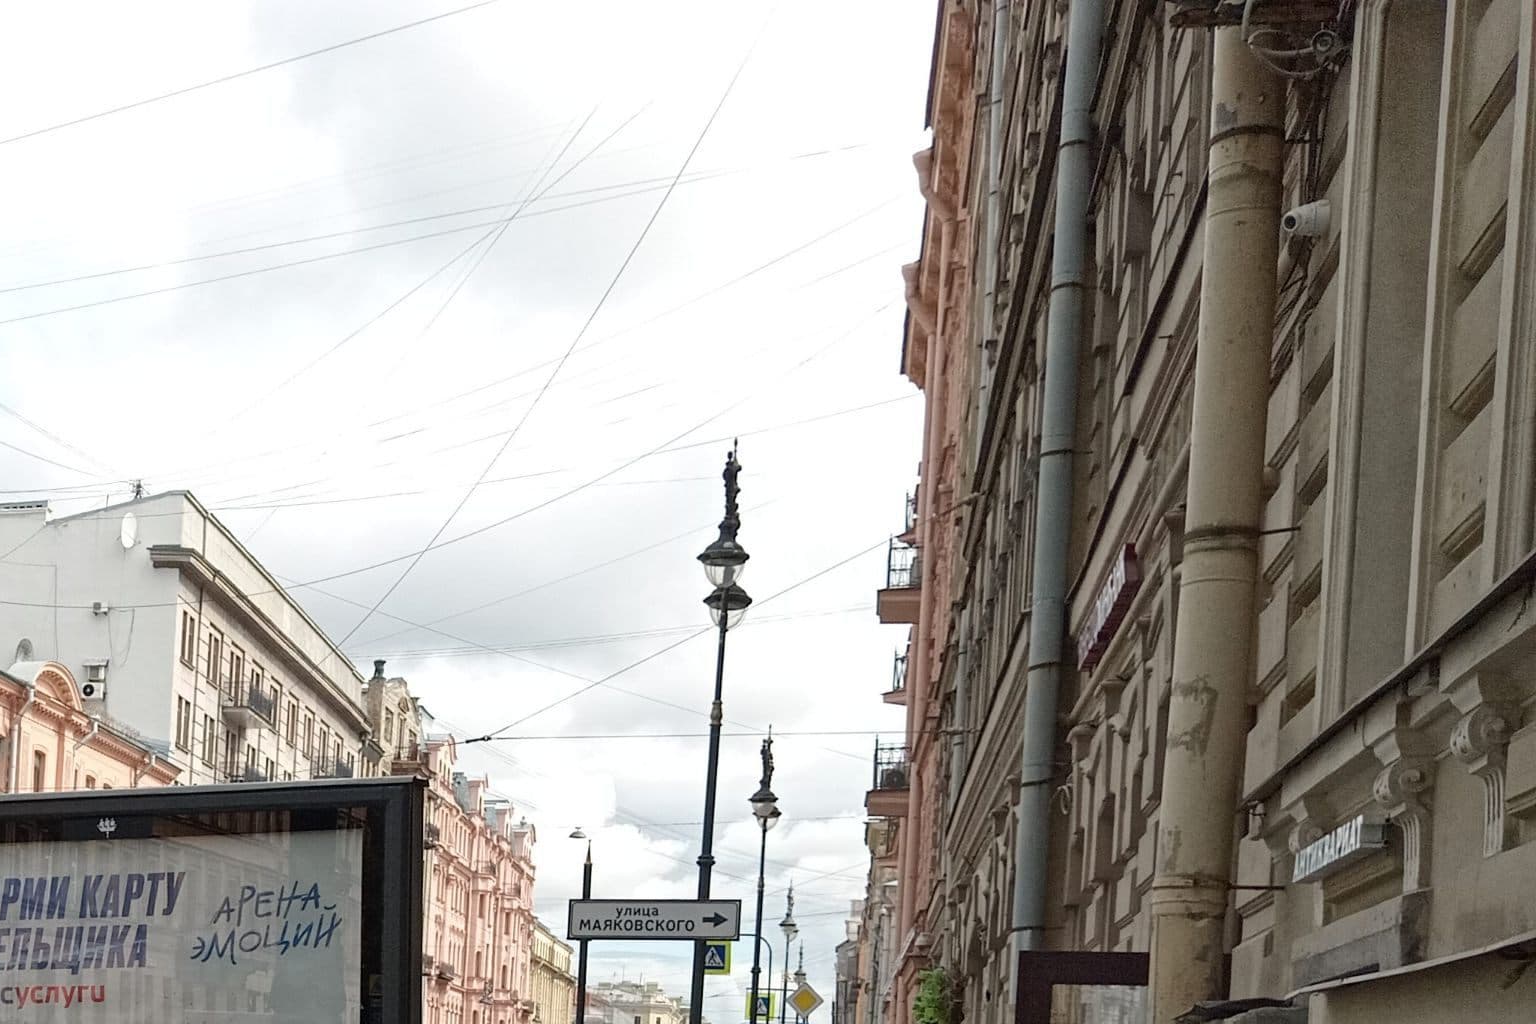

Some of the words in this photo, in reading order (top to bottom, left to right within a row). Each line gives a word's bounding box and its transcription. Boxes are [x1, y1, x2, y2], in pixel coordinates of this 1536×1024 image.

[79, 872, 186, 919] КАРТУ
[212, 880, 321, 927] АРЕНА
[578, 918, 696, 933] МАЯКОВСКОГО
[615, 905, 660, 918] улица
